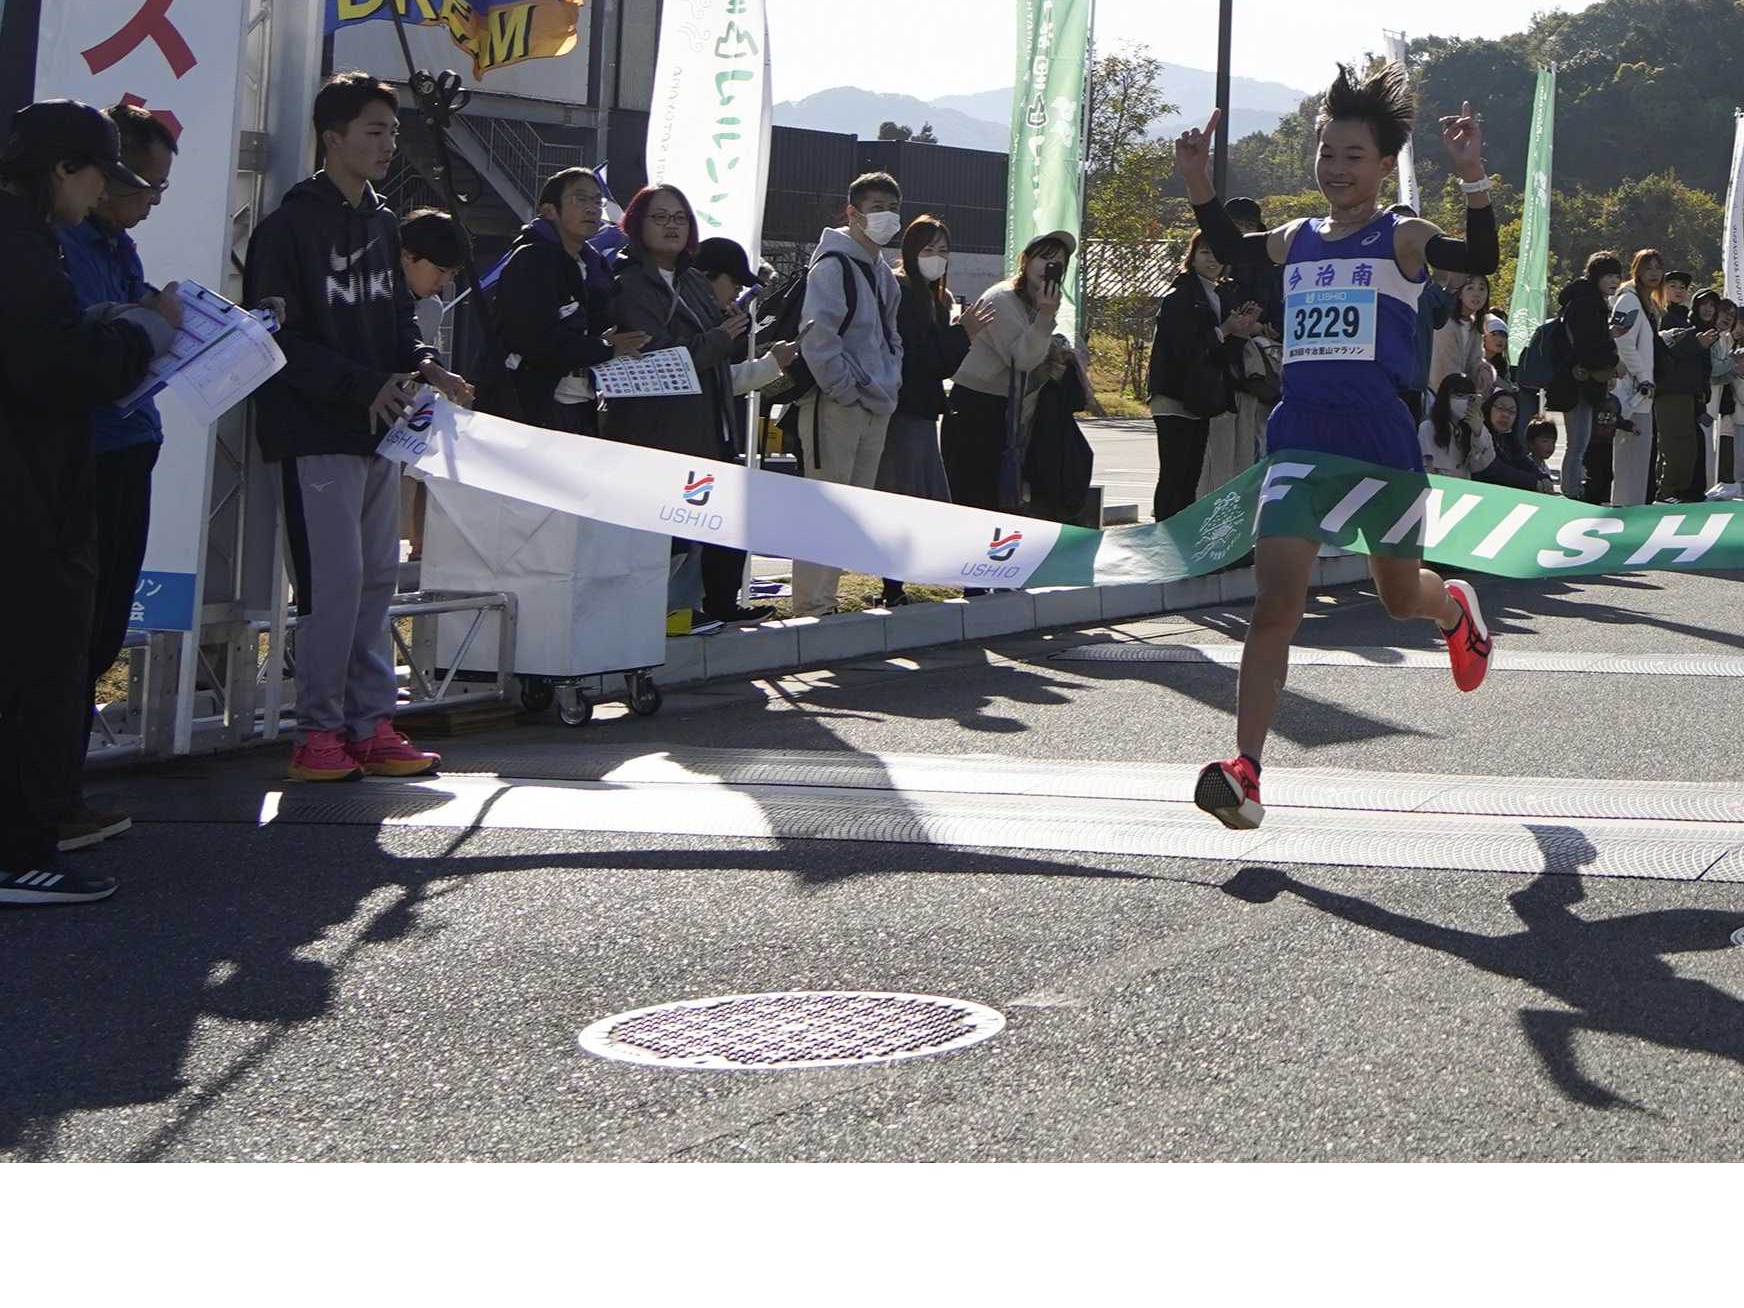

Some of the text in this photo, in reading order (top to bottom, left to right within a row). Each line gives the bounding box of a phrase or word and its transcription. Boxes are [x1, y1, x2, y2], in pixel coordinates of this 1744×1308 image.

[1288, 263, 1375, 291] 今治南
[1294, 305, 1360, 341] 3229
[659, 505, 723, 533] USHIO
[1251, 462, 1735, 570] FINISH
[961, 560, 1020, 580] USHIO
